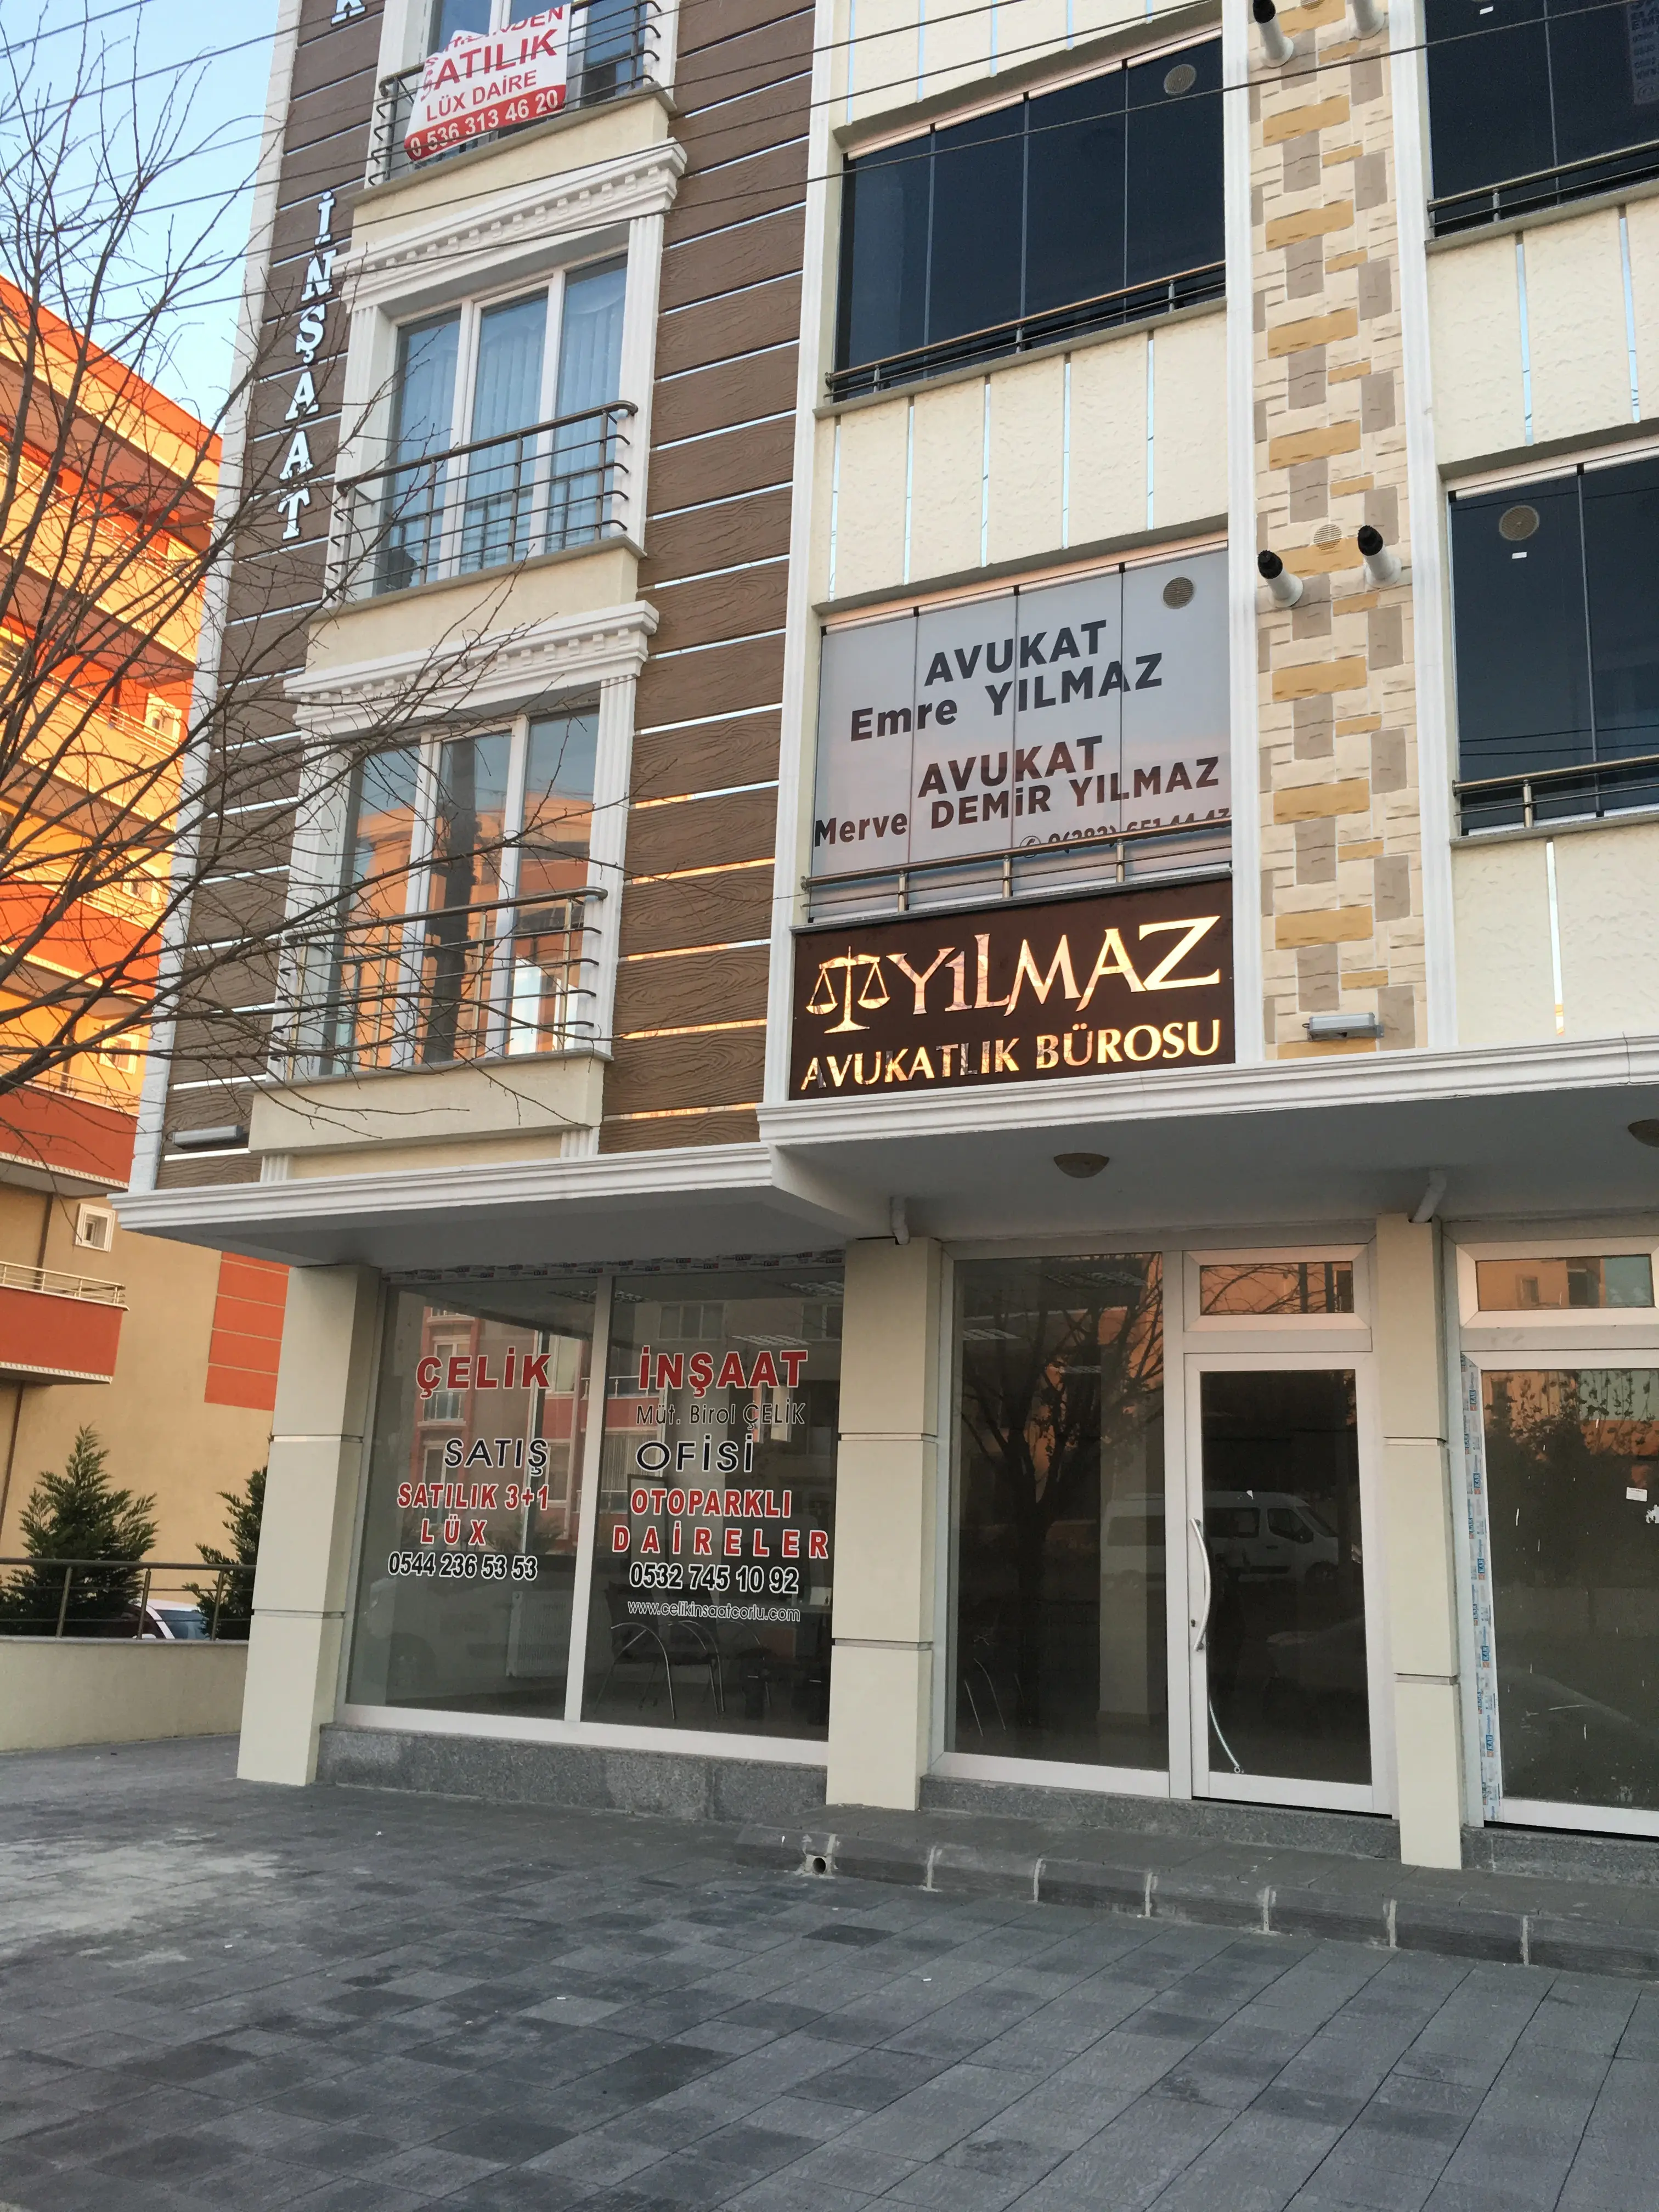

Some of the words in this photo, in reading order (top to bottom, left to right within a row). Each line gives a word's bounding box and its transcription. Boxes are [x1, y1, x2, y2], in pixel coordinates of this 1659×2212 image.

[426, 92, 466, 122] LÜX
[472, 70, 537, 106] DAİRE
[410, 137, 422, 156] 0
[427, 122, 459, 151] 536
[465, 109, 499, 135] 313
[505, 99, 529, 121] 46
[535, 89, 558, 114] 20
[278, 190, 338, 541] İNŞAAT
[924, 620, 1107, 686] AVUKAT
[851, 699, 957, 741] Emre
[985, 653, 1162, 716] YILMAZ
[918, 736, 1102, 798] AVUKAT
[815, 812, 907, 847] Merve
[1069, 757, 1219, 807] YILMAZ
[802, 1037, 1020, 1090] AVUKATLIK
[1037, 1019, 1220, 1069] BÜROSU
[415, 1346, 552, 1399] ÇELİK
[637, 1345, 808, 1398] İNŞAAT
[636, 1404, 680, 1425] Müt.
[690, 1403, 736, 1425] Birol
[742, 1398, 806, 1430] ÇELİK
[444, 1438, 548, 1476] SATIŞ
[635, 1434, 754, 1472] OFİSİ
[397, 1482, 498, 1509] SATILIK
[505, 1485, 549, 1510] 3+1
[630, 1488, 792, 1518] OTOPARKLI
[420, 1514, 488, 1546] LÜX
[612, 1520, 830, 1559] DAİRELER
[388, 1551, 436, 1577] 0544
[439, 1553, 477, 1578] 236
[481, 1555, 507, 1579] 53
[511, 1556, 538, 1581] 53
[629, 1561, 684, 1589] 0532
[688, 1563, 731, 1591] 745
[735, 1565, 764, 1593] 10
[769, 1566, 799, 1594] 92
